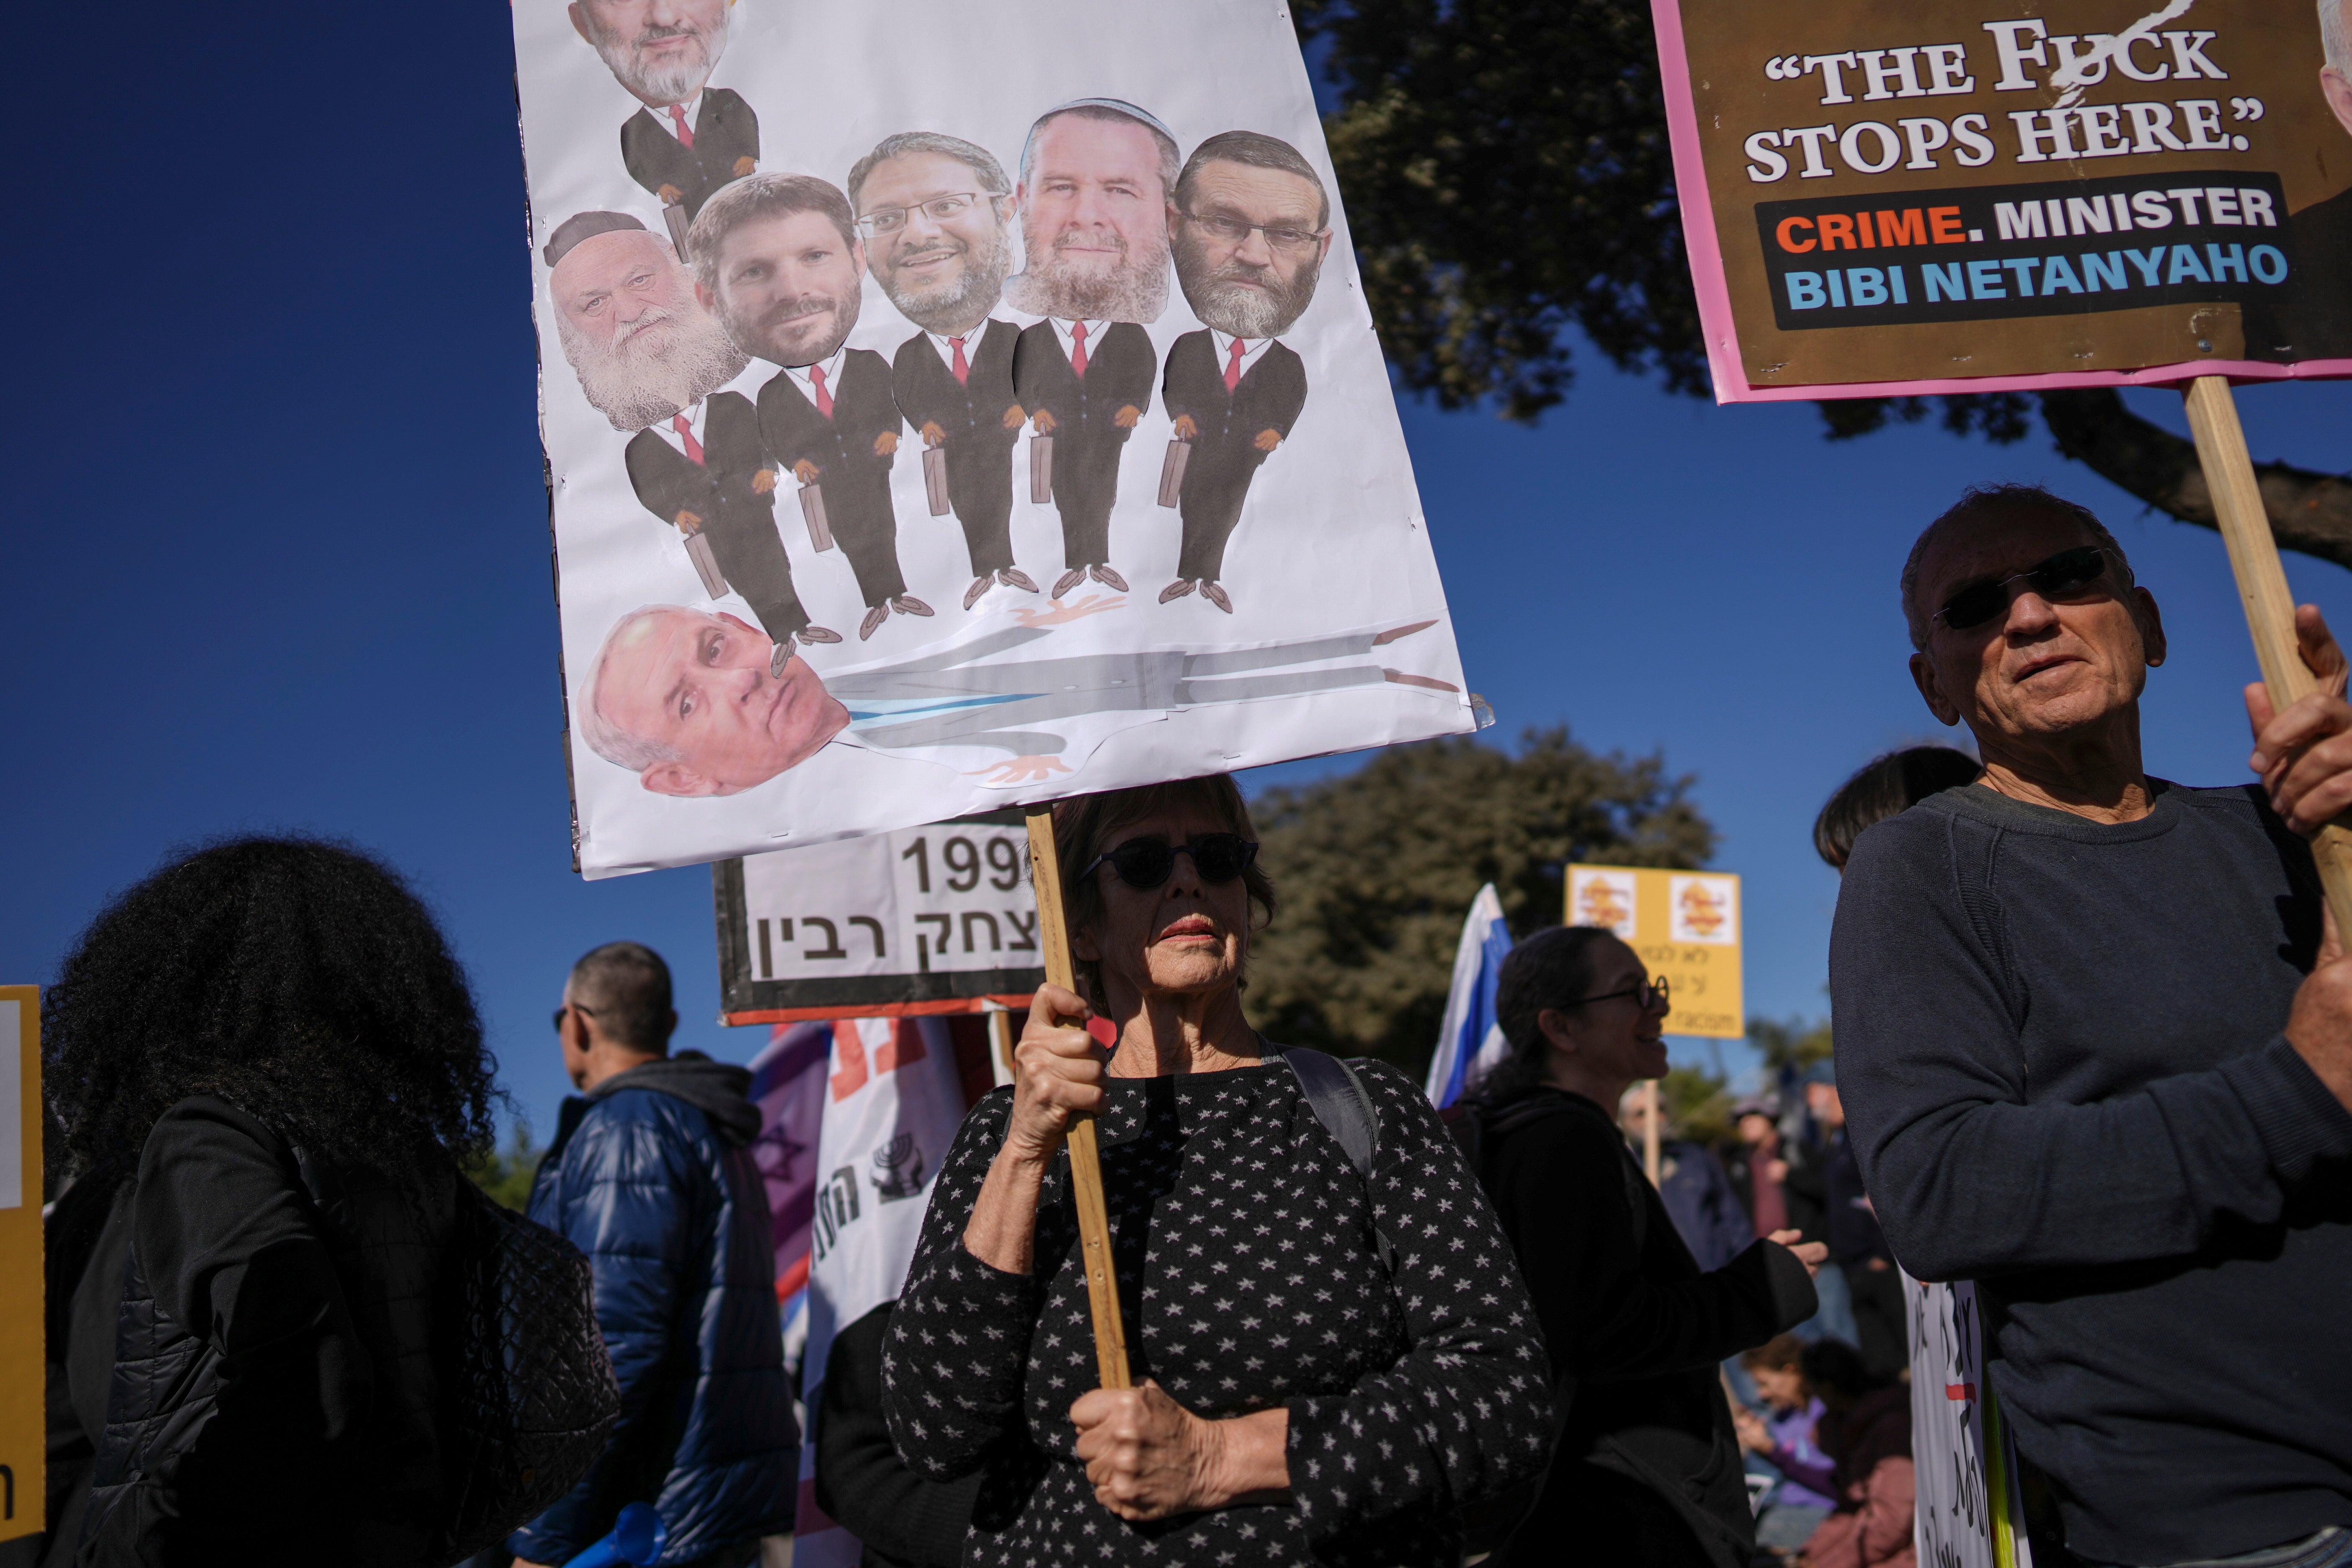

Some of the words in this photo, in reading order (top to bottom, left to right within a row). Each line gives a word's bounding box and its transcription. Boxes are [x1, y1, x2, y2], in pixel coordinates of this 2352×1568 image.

[1764, 42, 1975, 106] “THE
[1982, 18, 2228, 92] FUCK
[1743, 111, 1996, 183] STOPS
[2007, 97, 2264, 164] HERE.”
[1775, 205, 1984, 254] CRIME.
[1993, 186, 2277, 240] MINISTER
[1784, 266, 1908, 311] BIBI
[1921, 242, 2289, 303] NETANYAHO
[902, 836, 1021, 892] 199
[757, 916, 886, 979] רבין
[914, 910, 1037, 973] צחק
